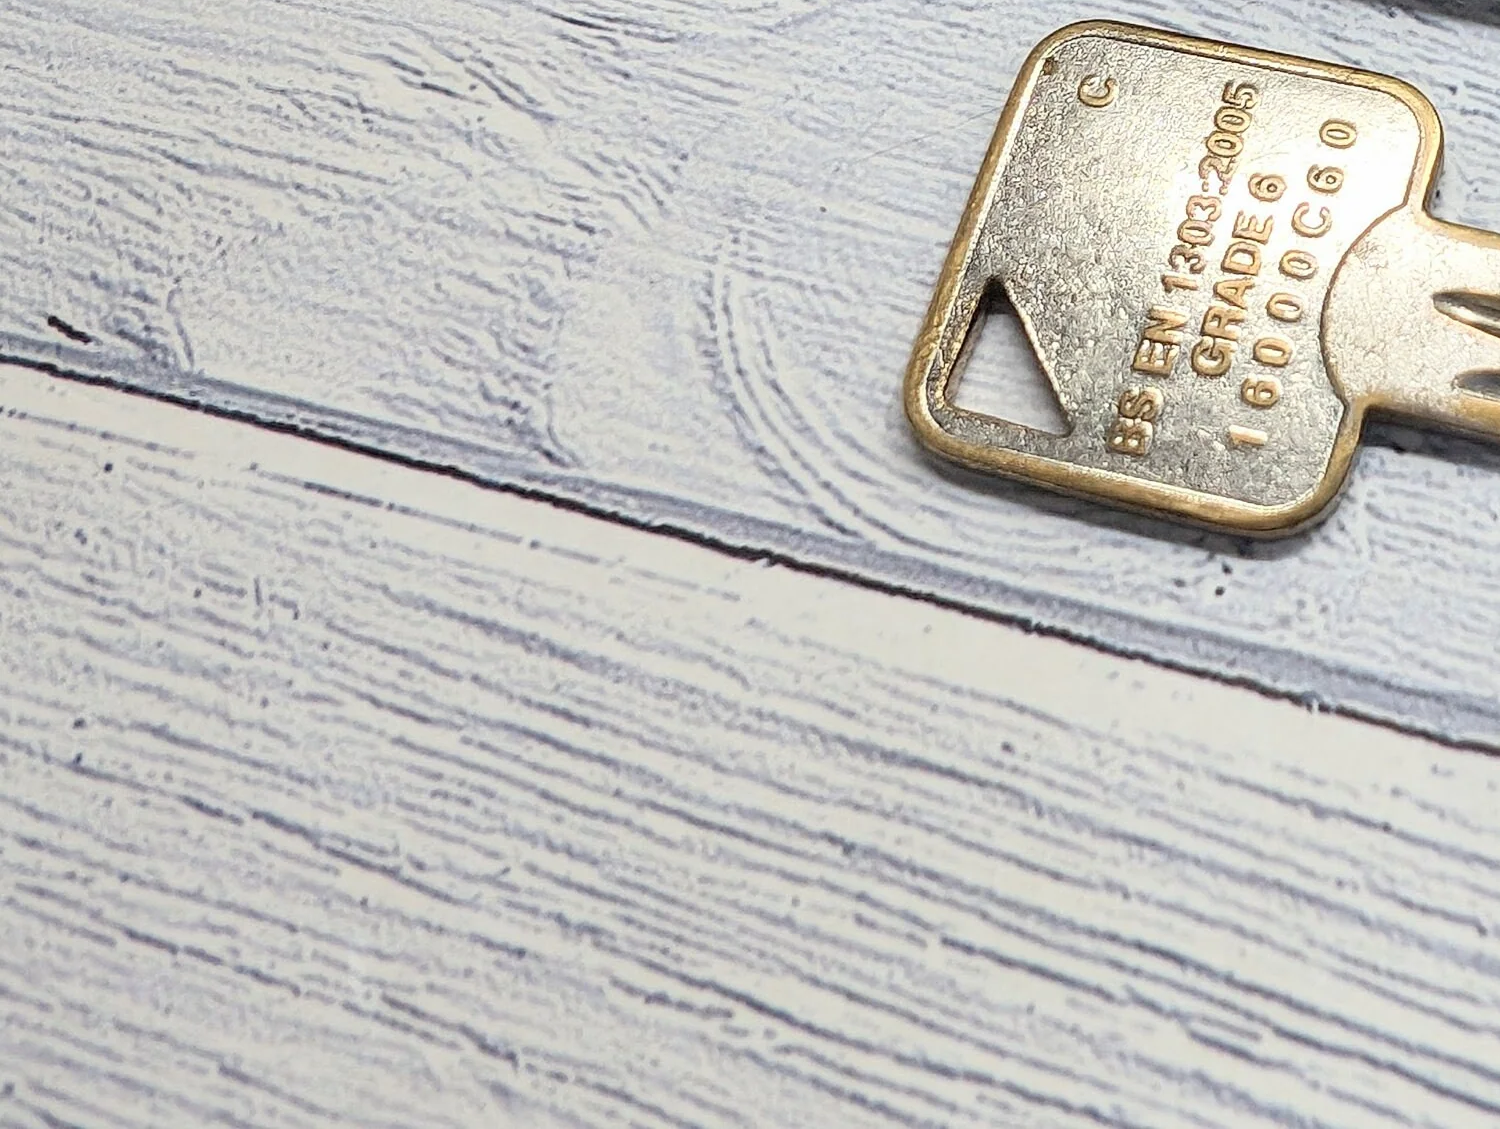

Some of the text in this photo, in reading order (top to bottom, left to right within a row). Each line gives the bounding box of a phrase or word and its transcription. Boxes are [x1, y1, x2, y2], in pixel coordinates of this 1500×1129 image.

[1077, 76, 1119, 108] C
[1191, 172, 1286, 378] GRADE 6
[1132, 306, 1185, 376] EN
[1106, 386, 1166, 456] BS
